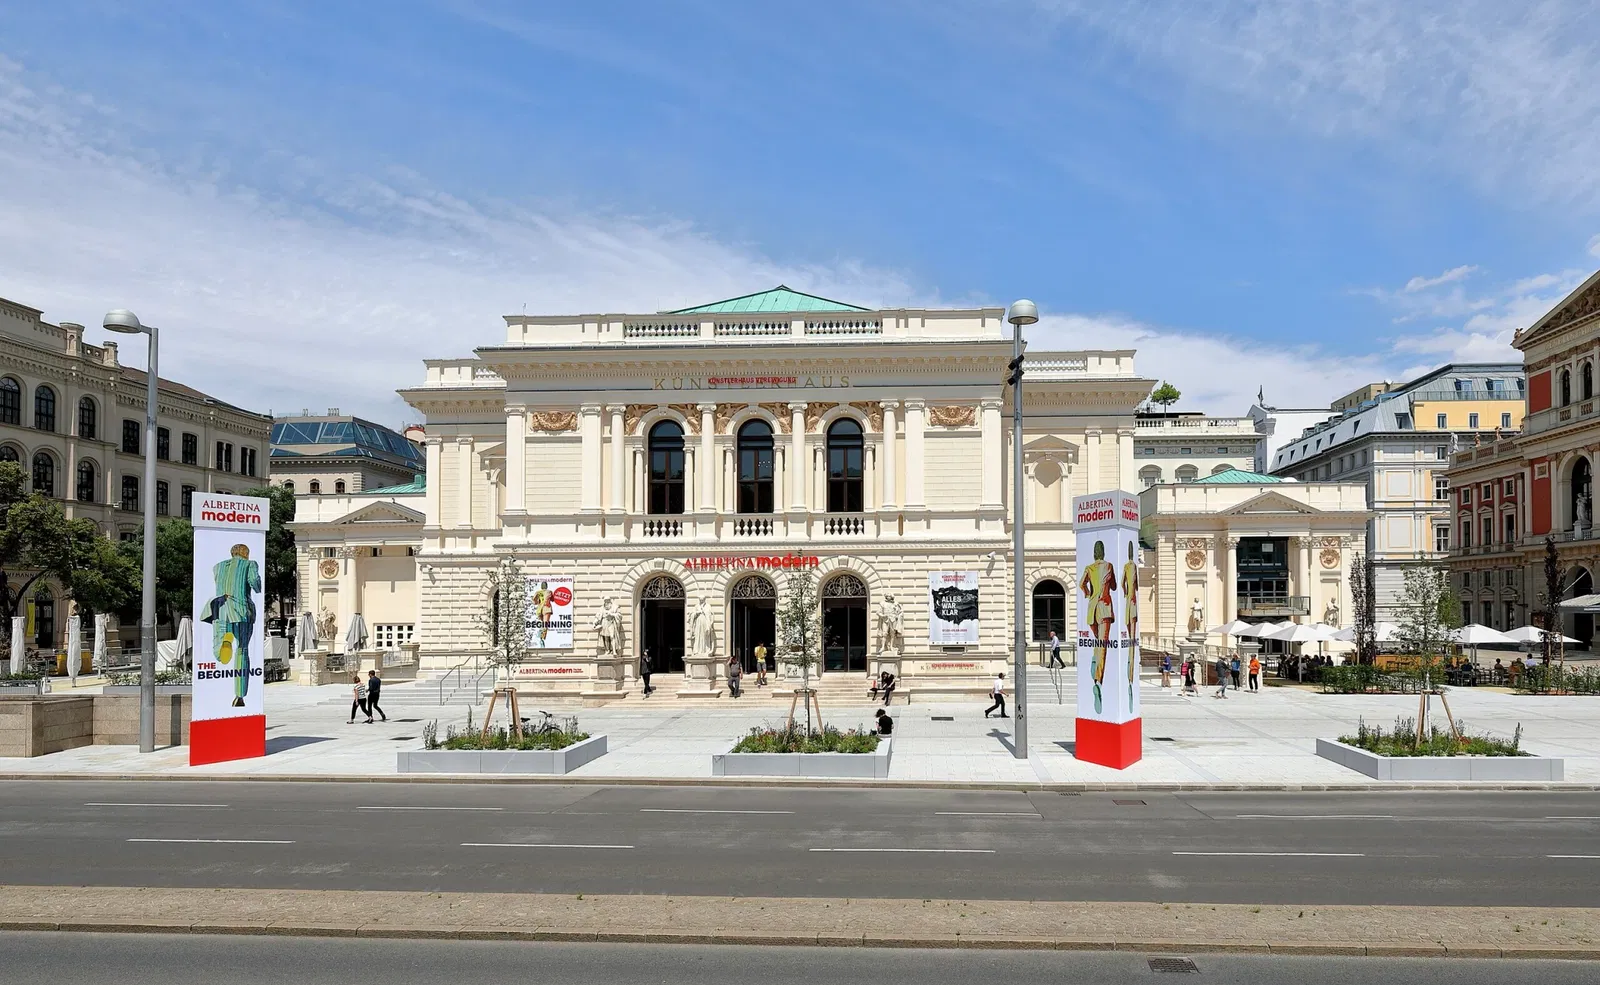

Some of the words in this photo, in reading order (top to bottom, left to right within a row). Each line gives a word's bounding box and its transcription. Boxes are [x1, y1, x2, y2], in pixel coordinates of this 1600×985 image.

[202, 500, 260, 512] ALBERTINA
[1078, 498, 1114, 511] ALBERTINA
[202, 511, 261, 524] modern
[1078, 509, 1114, 523] modern
[684, 557, 755, 569] ALBERTINA
[756, 553, 819, 569] modern
[1079, 638, 1118, 649] BEGINNING
[198, 668, 262, 680] BEGINNING
